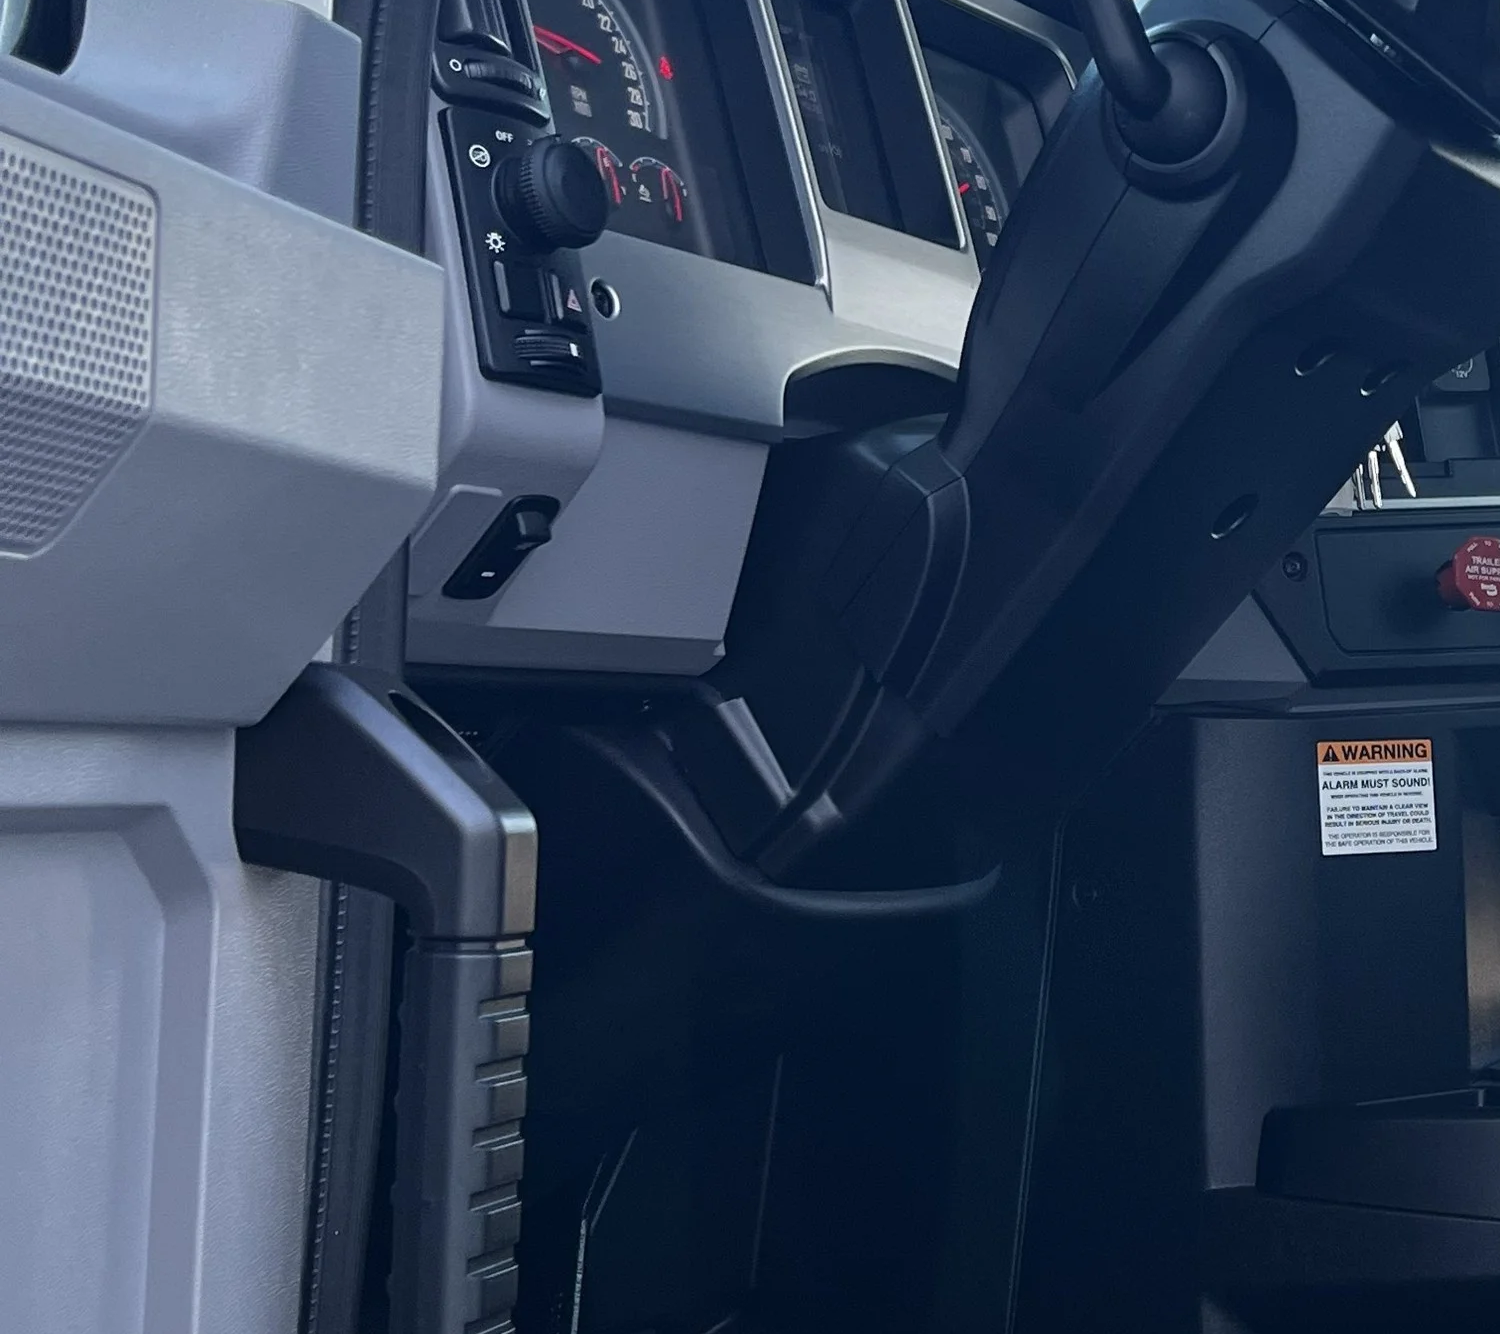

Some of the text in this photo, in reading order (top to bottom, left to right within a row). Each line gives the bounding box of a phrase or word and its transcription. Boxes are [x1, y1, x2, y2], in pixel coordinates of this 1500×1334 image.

[598, 13, 613, 33] 22
[612, 36, 627, 54] 24
[622, 61, 637, 81] 26
[627, 86, 643, 106] 28
[627, 110, 643, 129] 30
[495, 130, 513, 143] OFF
[1465, 566, 1479, 575] AIR
[1341, 743, 1427, 761] WARNING
[1322, 777, 1430, 790] ALARM MUST SOUND!
